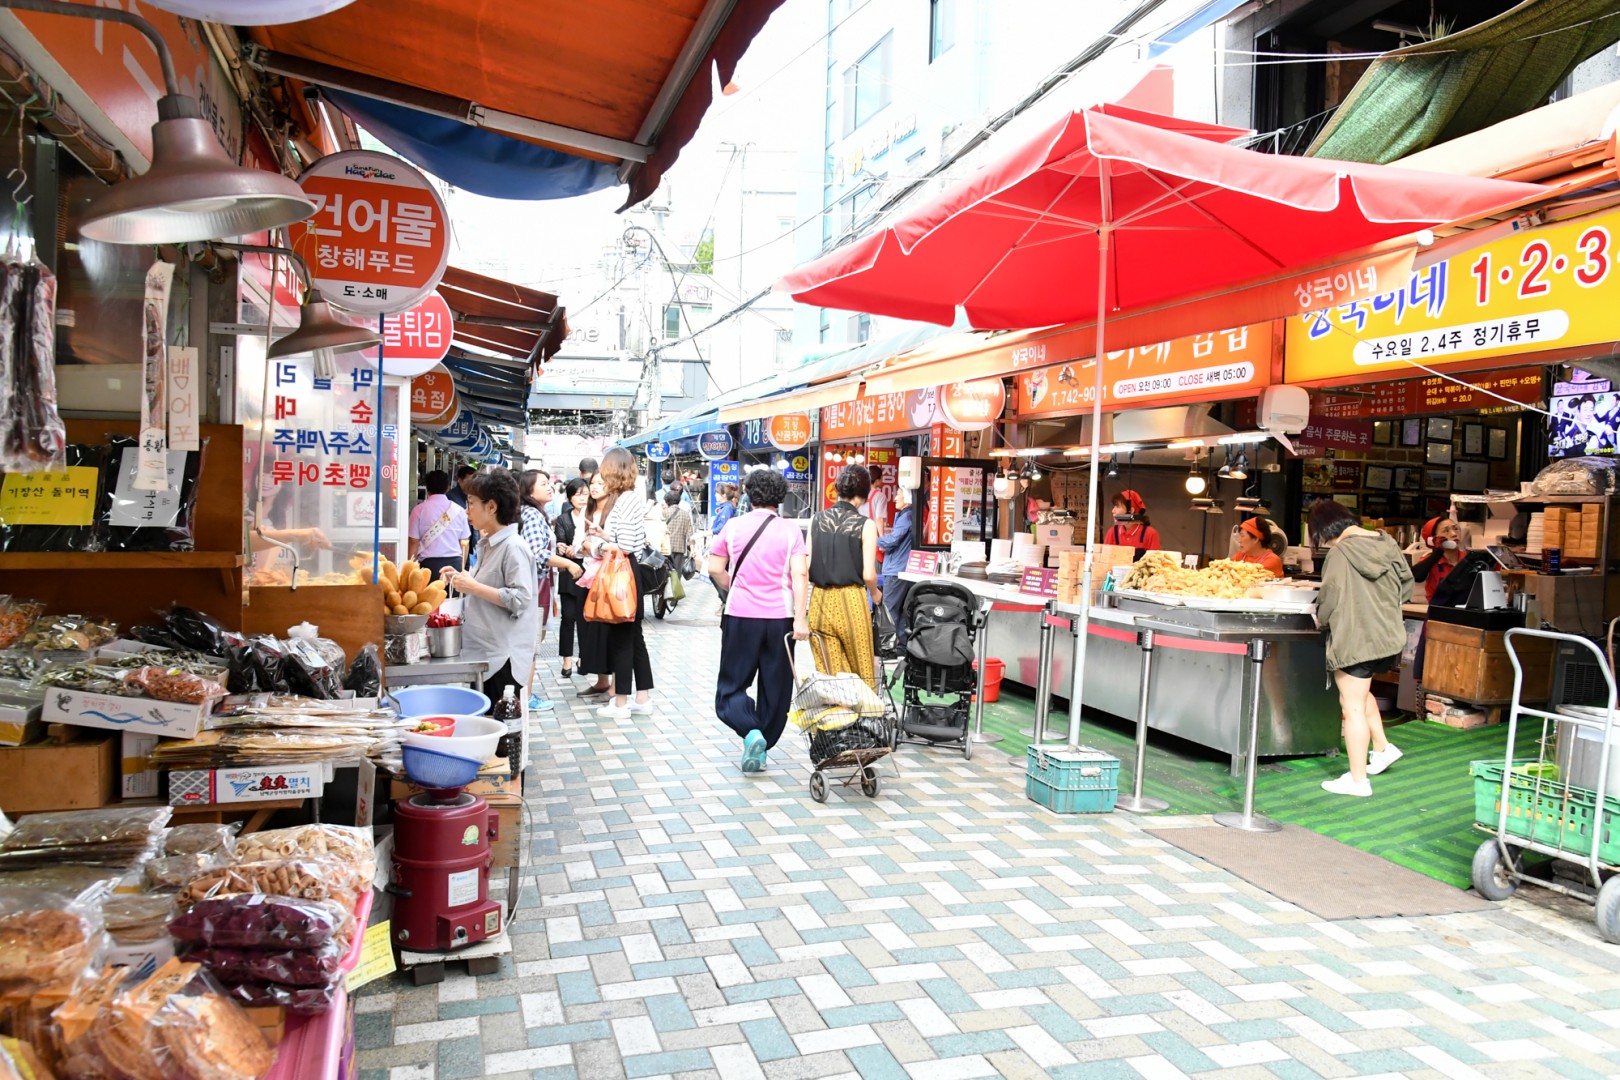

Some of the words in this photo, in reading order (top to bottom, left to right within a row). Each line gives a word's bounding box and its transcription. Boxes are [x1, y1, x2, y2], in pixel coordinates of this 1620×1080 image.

[307, 194, 437, 247] 건어물
[318, 245, 415, 274] 창해푸드
[343, 285, 388, 300] 도·소매
[1294, 265, 1377, 308] 상국이네
[1371, 337, 1412, 360] 수요일
[1473, 319, 1541, 346] 정기휴무
[1011, 344, 1046, 366] 상국이네
[1118, 383, 1137, 395] OPEN
[1137, 381, 1151, 393] 오전
[1152, 378, 1172, 390] 09:00
[1178, 374, 1204, 387] CLOSE
[1205, 371, 1221, 384] 새벽
[1222, 367, 1247, 381] 05:00
[1051, 384, 1107, 407] T.742-901
[824, 403, 847, 430] 이름난
[877, 391, 906, 422] 곰장어
[1305, 425, 1323, 439] 음식
[1325, 428, 1357, 443] 주문하는
[1360, 432, 1368, 445] 곳
[794, 458, 806, 469] 산
[8, 487, 45, 498] 기장산
[52, 487, 89, 499] 돌미역
[288, 777, 311, 789] 멸치
